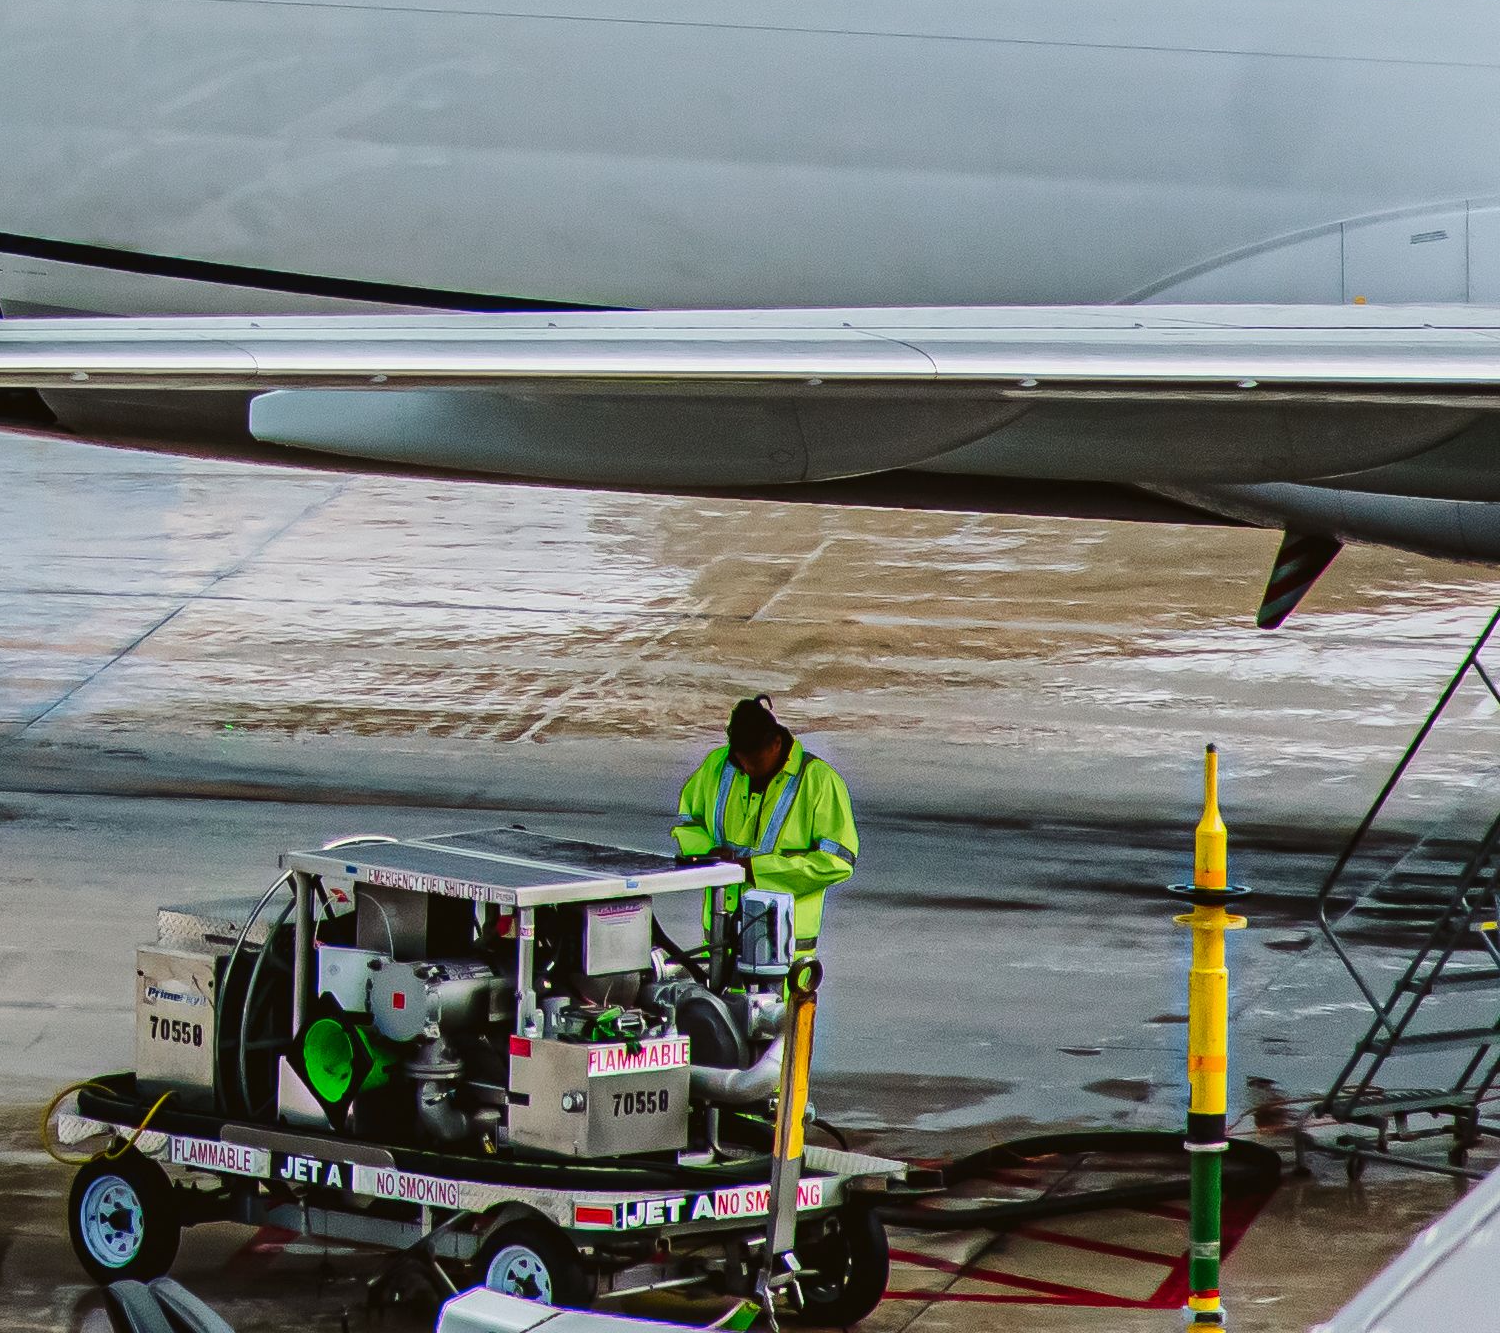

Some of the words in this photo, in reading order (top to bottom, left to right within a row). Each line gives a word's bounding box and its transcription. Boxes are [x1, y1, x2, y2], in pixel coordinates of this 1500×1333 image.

[369, 869, 419, 888] EMERGENCY
[421, 878, 441, 893] FUEL
[444, 881, 466, 897] SHUT
[469, 885, 484, 900] OFF
[590, 1043, 690, 1073] FLAMMABLE
[174, 1140, 251, 1171] FLAMMABLE
[281, 1156, 322, 1182] JET
[327, 1164, 342, 1188] A
[376, 1172, 395, 1195] NO
[398, 1176, 457, 1206] SMOKING
[718, 1193, 739, 1216] NO
[746, 1183, 821, 1213] SMNG
[627, 1198, 686, 1228] JET
[692, 1195, 716, 1220] A
